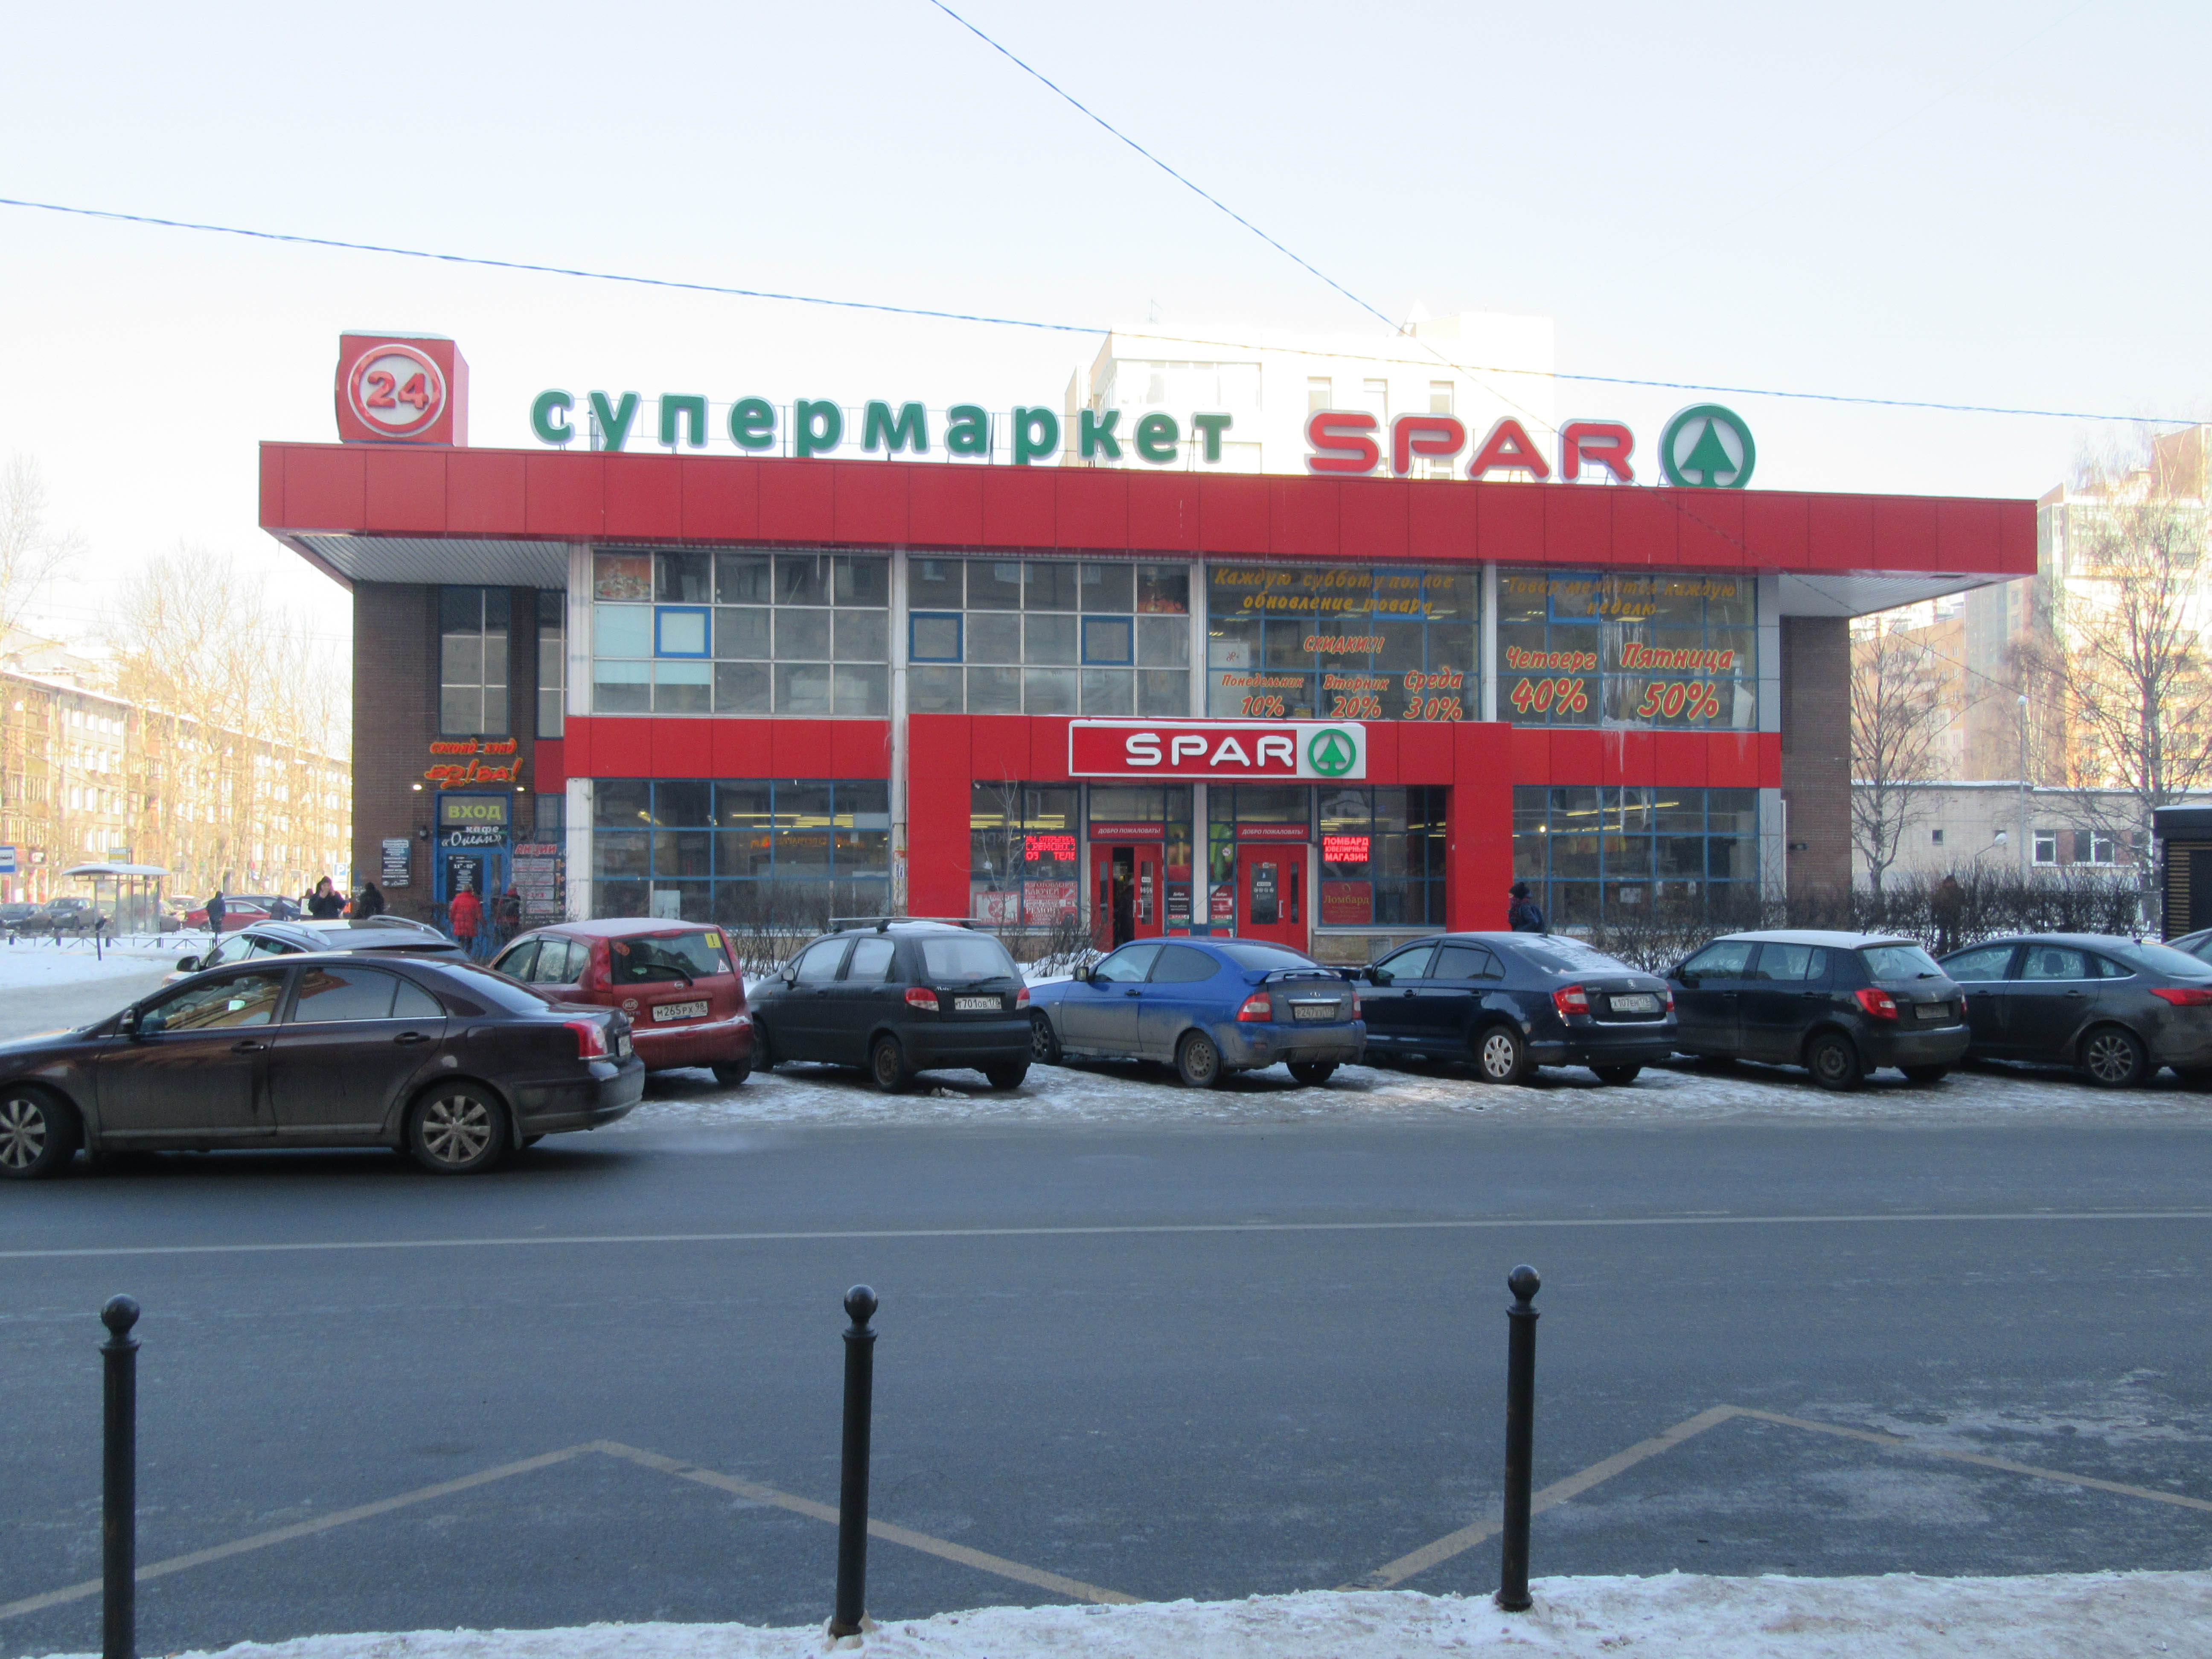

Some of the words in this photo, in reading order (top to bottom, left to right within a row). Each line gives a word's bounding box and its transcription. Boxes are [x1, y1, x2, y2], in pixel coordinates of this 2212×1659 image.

[366, 370, 429, 410] 24
[530, 388, 1233, 468] супермаркет
[1304, 409, 1636, 486] SPAR
[1214, 568, 1292, 589] Каждую
[1302, 570, 1385, 591] субботу
[1508, 576, 1559, 596] Товар
[1665, 580, 1737, 601] каждую
[1243, 591, 1354, 610] обновление
[1363, 597, 1433, 615] товара
[1586, 597, 1656, 615] неделю
[1304, 635, 1385, 654] СКИДКИ!!!
[1506, 645, 1597, 674] Четверг
[1620, 642, 1735, 675] Пятница
[1221, 672, 1304, 688] Понедельник
[1322, 674, 1390, 693] Вторник
[1403, 667, 1464, 693] Среда
[1240, 695, 1285, 718] 10%
[1330, 696, 1382, 720] 20%
[1511, 678, 1588, 715] 40%
[1636, 682, 1720, 720] 50%
[1403, 696, 1463, 722] 30%
[1126, 733, 1294, 767] SPAR
[448, 805, 502, 821] ВХОД
[1323, 837, 1369, 846] ЛОМБАРД
[1324, 853, 1368, 862] МАГАЗИН
[1324, 895, 1370, 906] Ломбард
